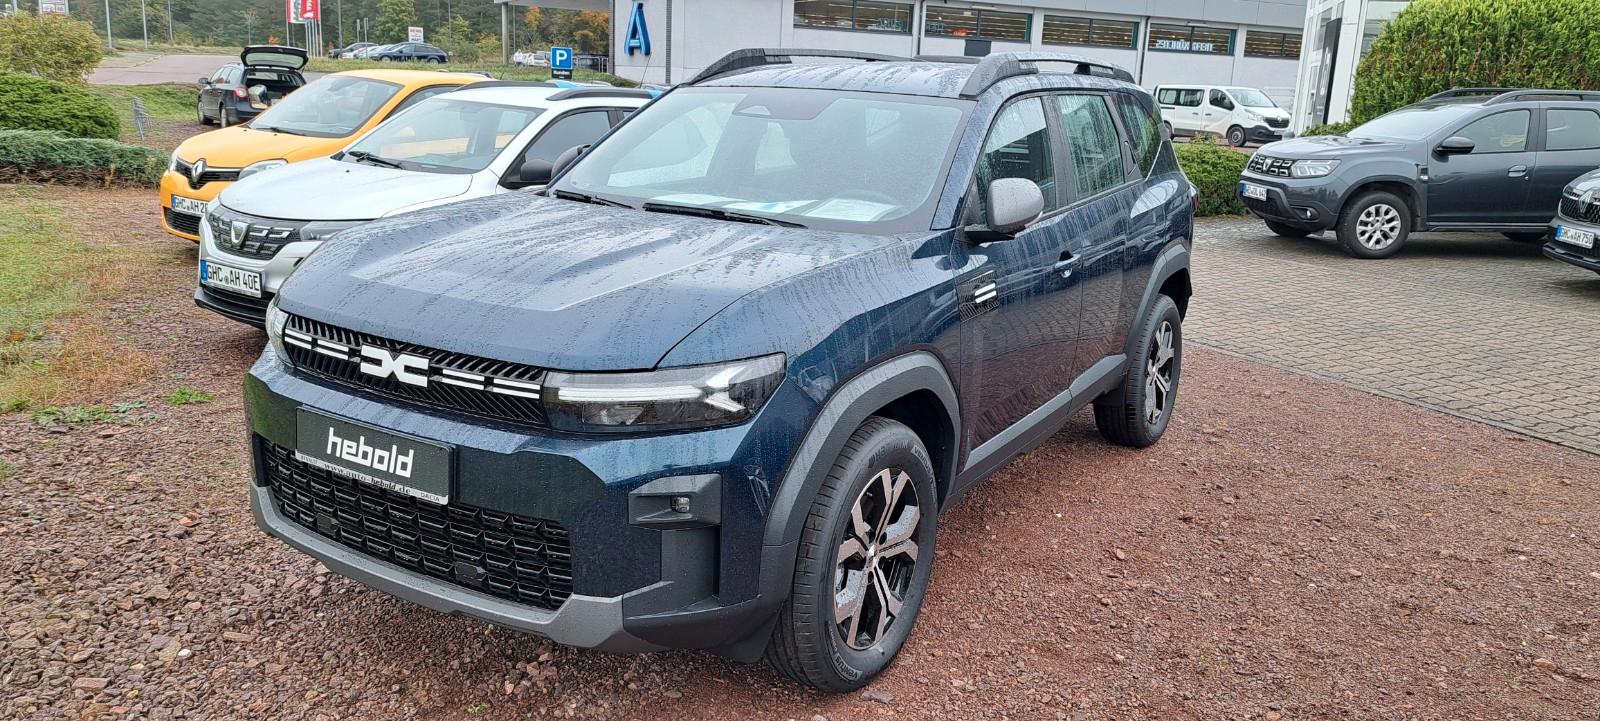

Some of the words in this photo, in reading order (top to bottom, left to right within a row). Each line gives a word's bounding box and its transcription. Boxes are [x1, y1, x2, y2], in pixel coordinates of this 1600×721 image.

[623, 2, 651, 57] A
[556, 50, 568, 66] P
[190, 200, 200, 212] AH
[1582, 233, 1593, 244] 750
[207, 264, 224, 282] GHC
[229, 270, 241, 287] AH
[243, 273, 260, 292] 40E
[326, 427, 415, 479] hebold
[323, 463, 412, 495] www.auto-hebold.de
[420, 491, 441, 502] DACIA
